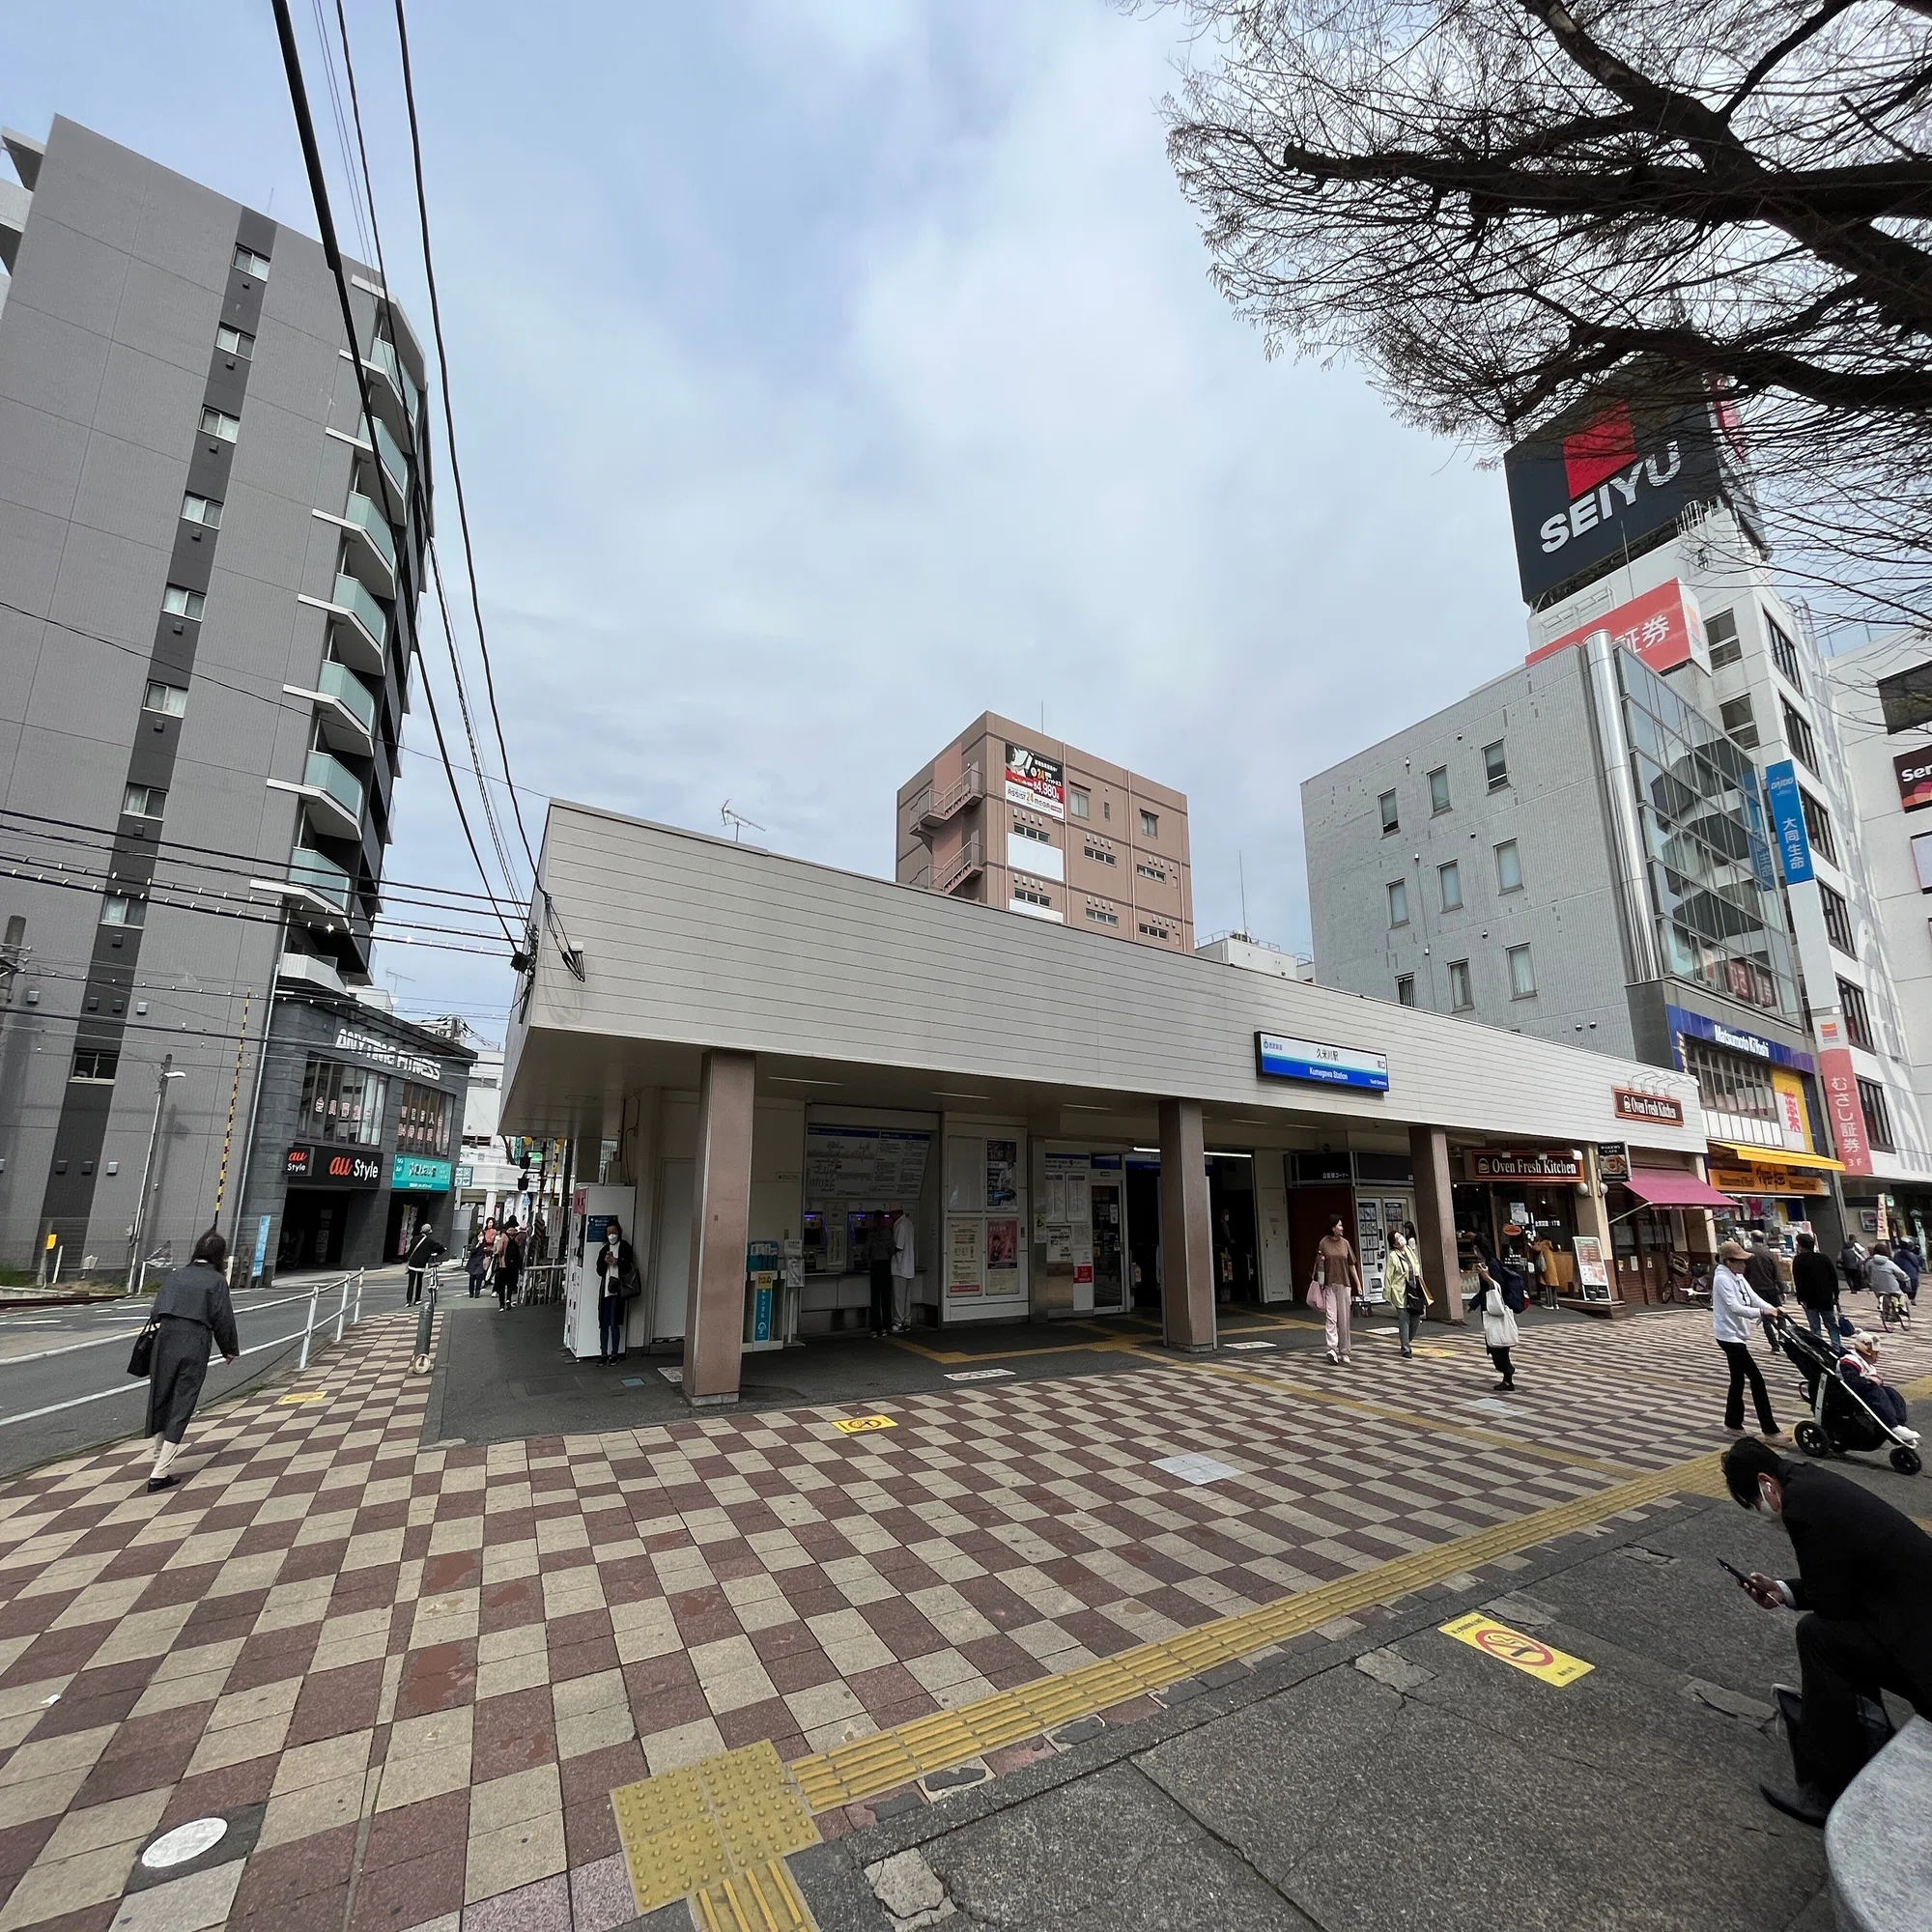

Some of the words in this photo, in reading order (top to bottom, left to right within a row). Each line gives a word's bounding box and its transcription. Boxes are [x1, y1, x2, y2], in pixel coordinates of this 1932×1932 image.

[1540, 440, 1681, 554] SEIYU
[1771, 778, 1794, 790] DAIDO
[1782, 817, 1804, 869] 大同生命
[1715, 1025, 1748, 1051] Matsumoto
[335, 1029, 396, 1065] ANYTIME
[397, 1050, 440, 1080] FITNESS
[1317, 1048, 1339, 1062] 久米川駅
[1333, 1070, 1348, 1080] Station
[1631, 1096, 1644, 1114] Oven
[1644, 1099, 1659, 1116] Fresh
[1659, 1101, 1676, 1119] Kitchen
[1832, 1077, 1861, 1152] むさし証券
[287, 1163, 305, 1172] Style
[289, 1151, 307, 1161] au
[1492, 1159, 1515, 1173] Oven
[1518, 1159, 1541, 1174] Fresh
[1544, 1159, 1577, 1174] Kitchen
[329, 1156, 353, 1176] au
[354, 1159, 378, 1180] Style
